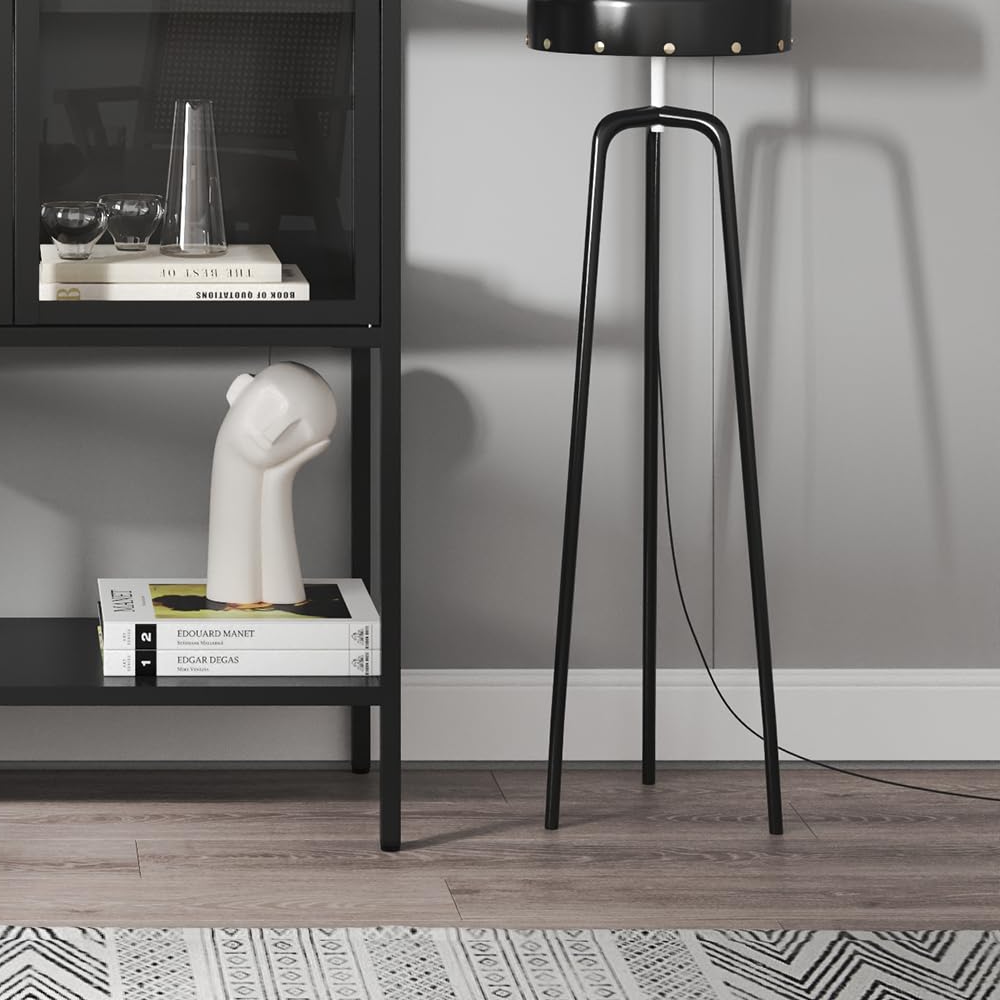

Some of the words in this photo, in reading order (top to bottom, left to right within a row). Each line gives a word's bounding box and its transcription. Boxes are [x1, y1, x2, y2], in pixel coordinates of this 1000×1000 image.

[195, 291, 253, 299] QUOTATIONS
[256, 291, 267, 299] OF
[270, 291, 296, 299] BOOK
[140, 631, 152, 642] 2
[177, 629, 222, 638] EDOUARD
[223, 629, 256, 638] MANET
[140, 659, 152, 667] 1
[177, 655, 208, 664] EDGAR
[209, 655, 240, 664] DEGAS
